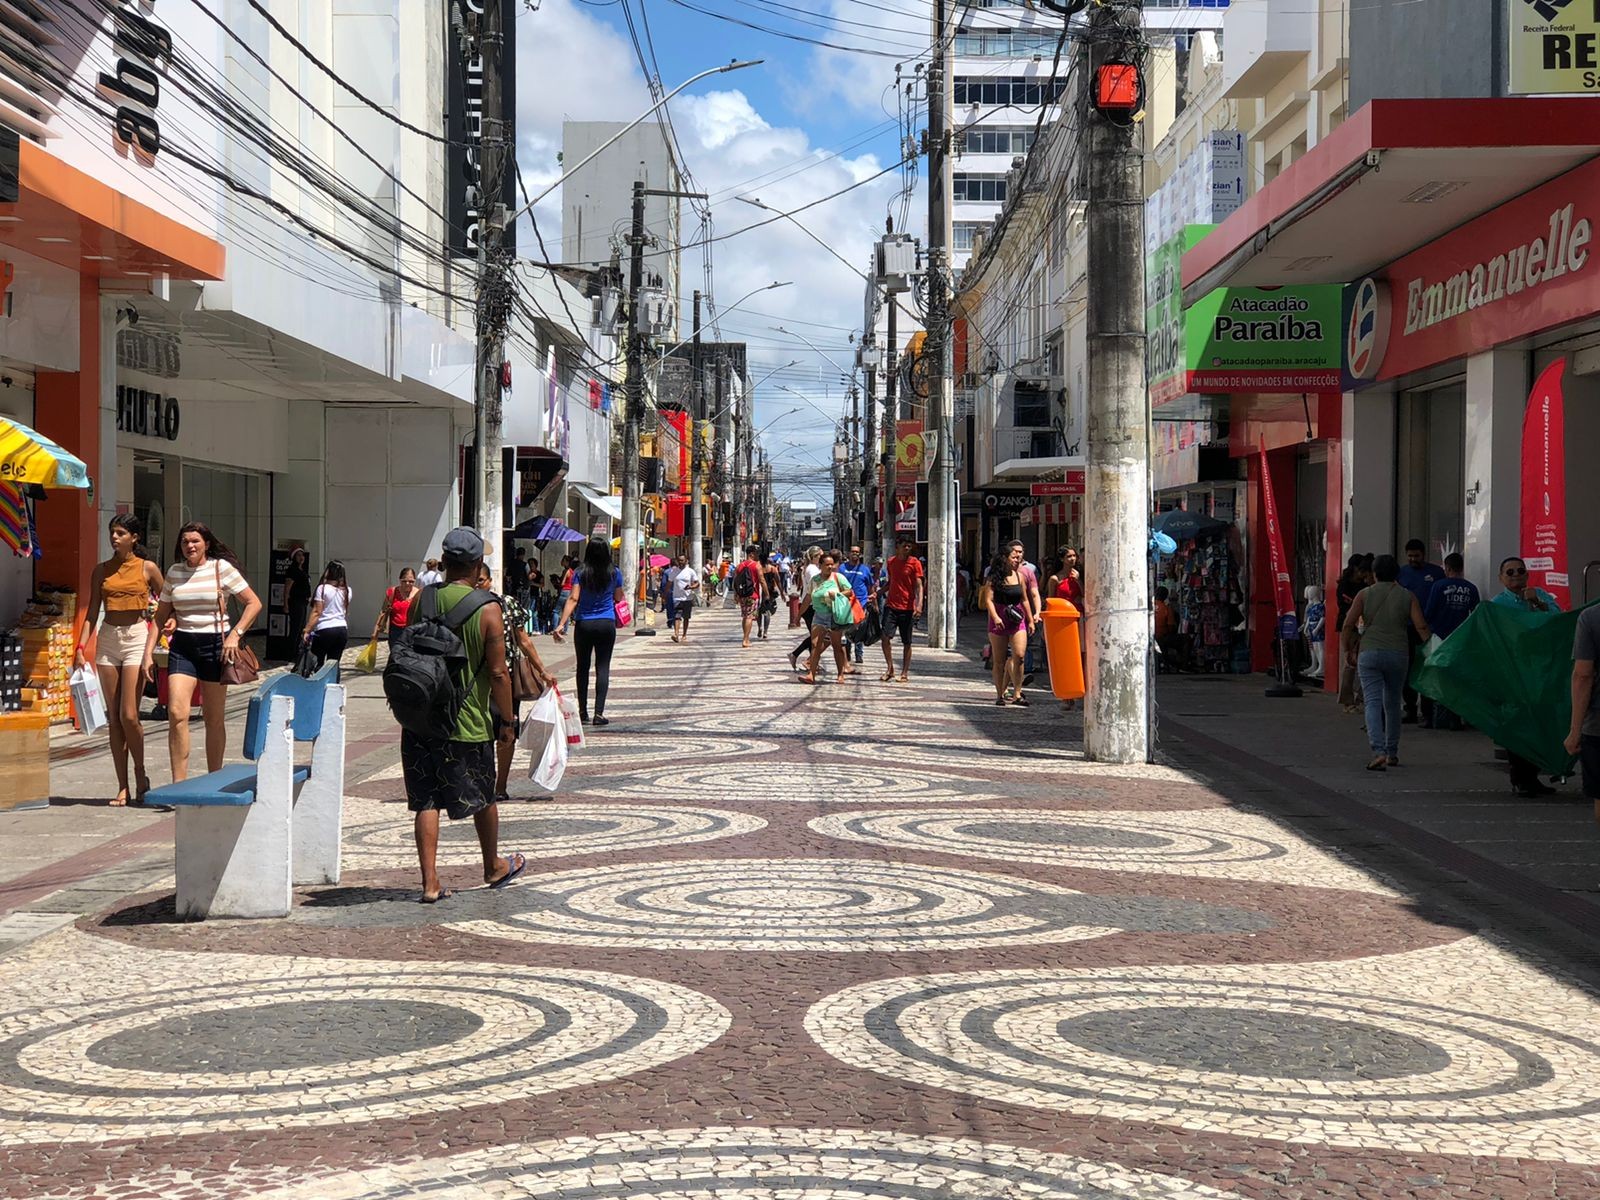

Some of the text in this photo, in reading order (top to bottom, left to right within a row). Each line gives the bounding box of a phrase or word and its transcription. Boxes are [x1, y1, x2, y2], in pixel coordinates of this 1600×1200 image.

[1523, 24, 1575, 33] Receita Federal
[1583, 71, 1600, 89] S
[1403, 203, 1591, 336] Emmanuelle
[1230, 296, 1309, 312] Atacadão
[1215, 314, 1322, 341] Paraíba
[1191, 374, 1339, 387] UM MUNDO DE NOVIDADES EM CONFECÇÕES
